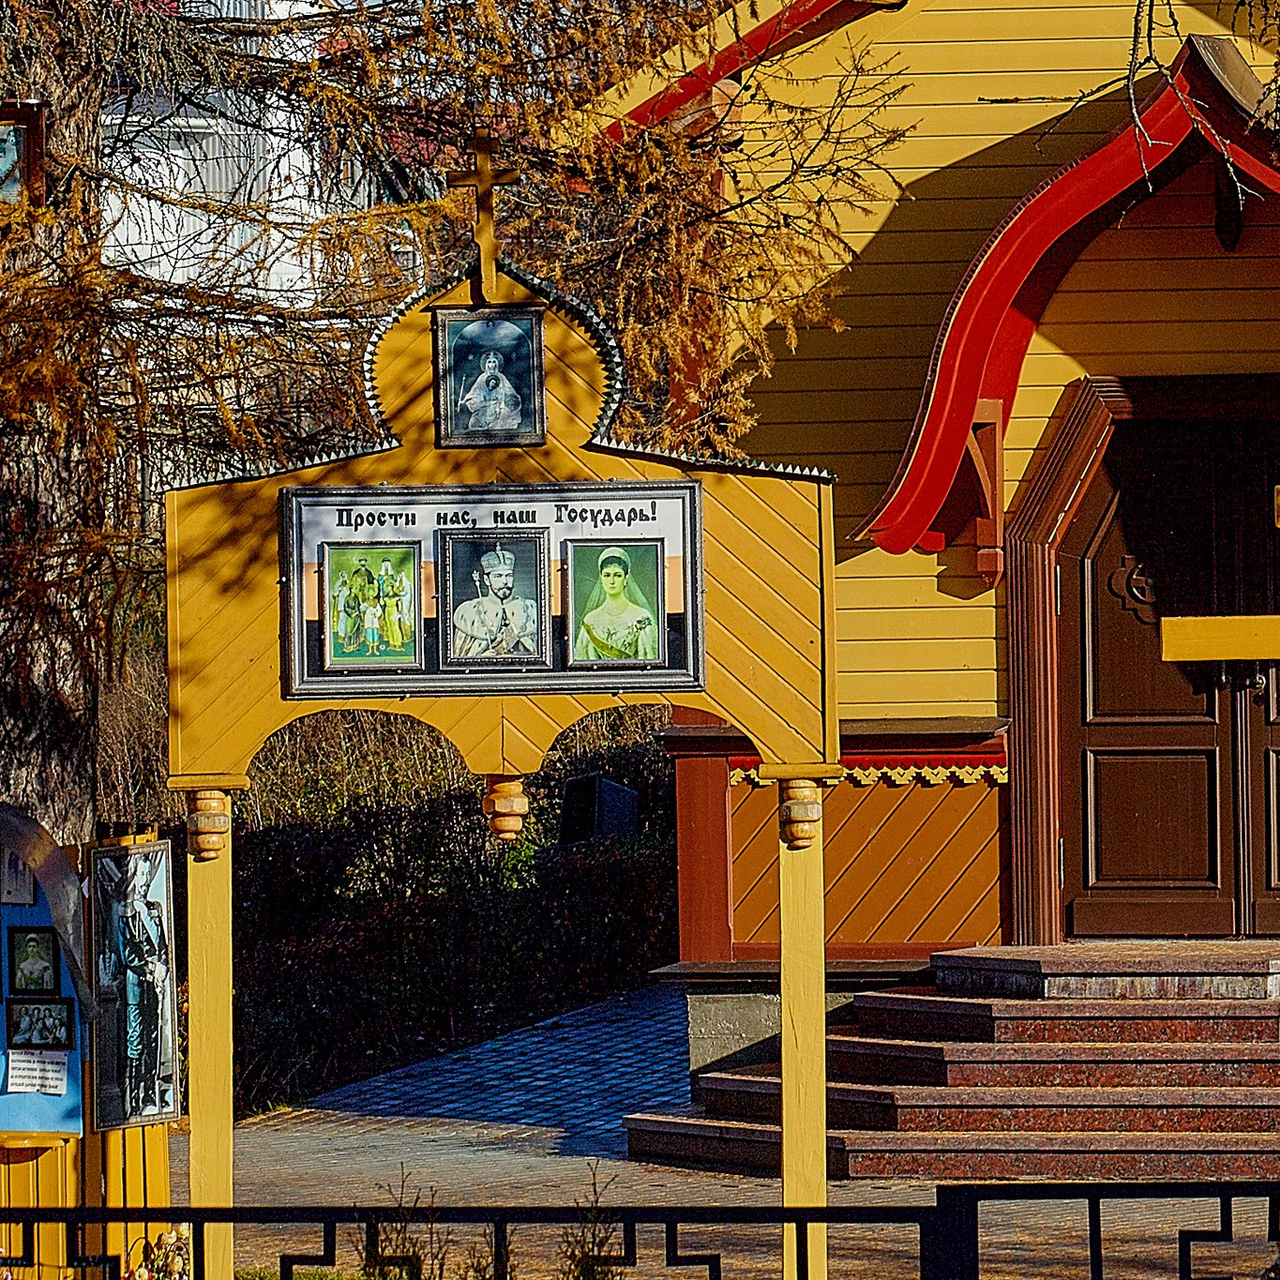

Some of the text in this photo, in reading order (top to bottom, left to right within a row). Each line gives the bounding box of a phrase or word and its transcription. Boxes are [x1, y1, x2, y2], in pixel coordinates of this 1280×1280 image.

[336, 501, 657, 532] Прости нас, наш Государь!
